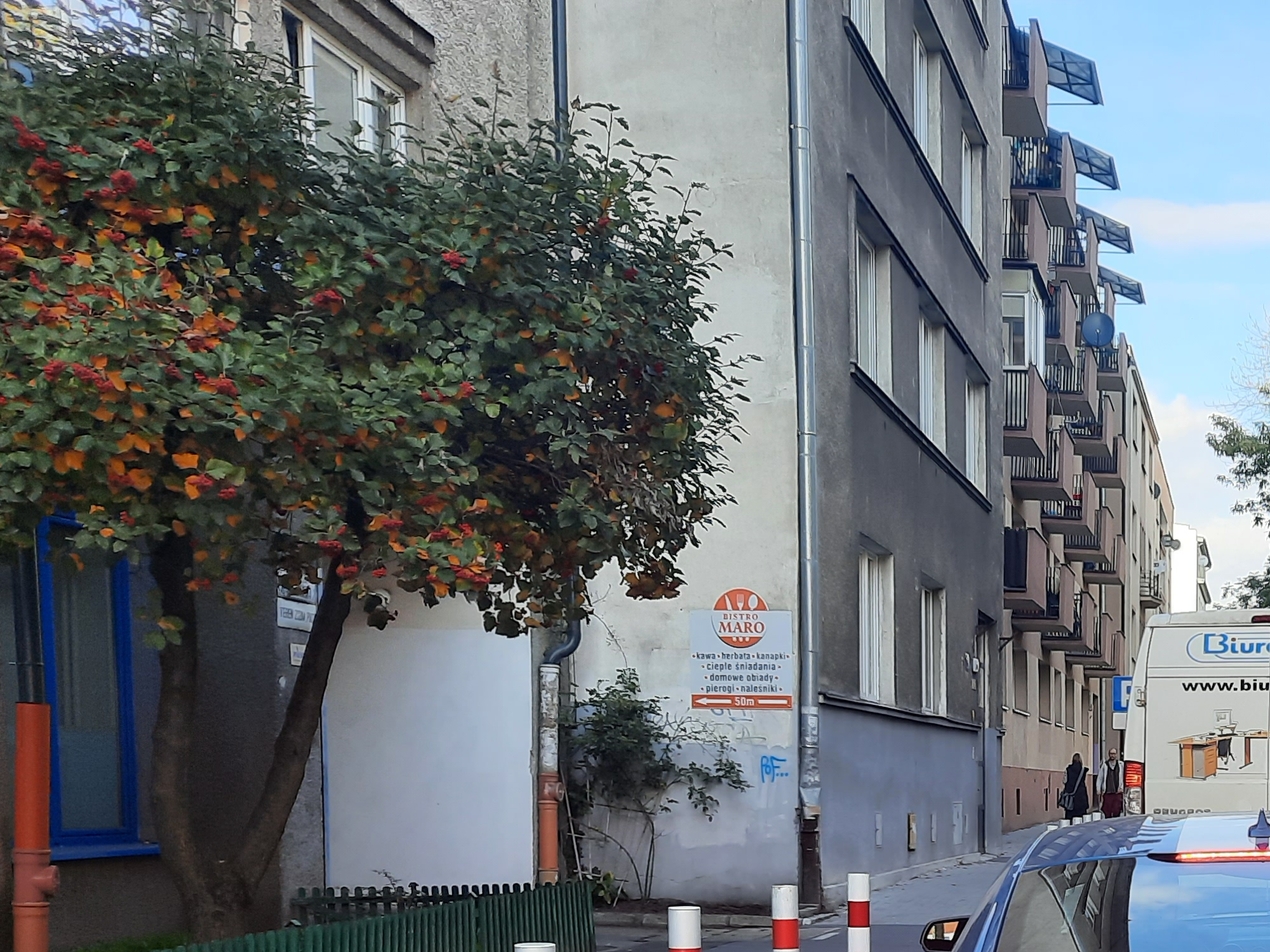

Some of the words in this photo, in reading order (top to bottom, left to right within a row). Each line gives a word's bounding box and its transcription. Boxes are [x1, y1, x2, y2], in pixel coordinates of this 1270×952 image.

[723, 613, 759, 621] BISTRO
[718, 621, 765, 634] MARO
[696, 652, 717, 660] kawa
[721, 651, 751, 660] herbata
[756, 652, 786, 661] kanapki
[735, 661, 776, 671] śniadania
[709, 673, 744, 682] domowe
[746, 673, 774, 683] obiady
[706, 684, 735, 694] pierogi
[740, 683, 778, 693] naleśniki
[734, 696, 755, 706] 50m
